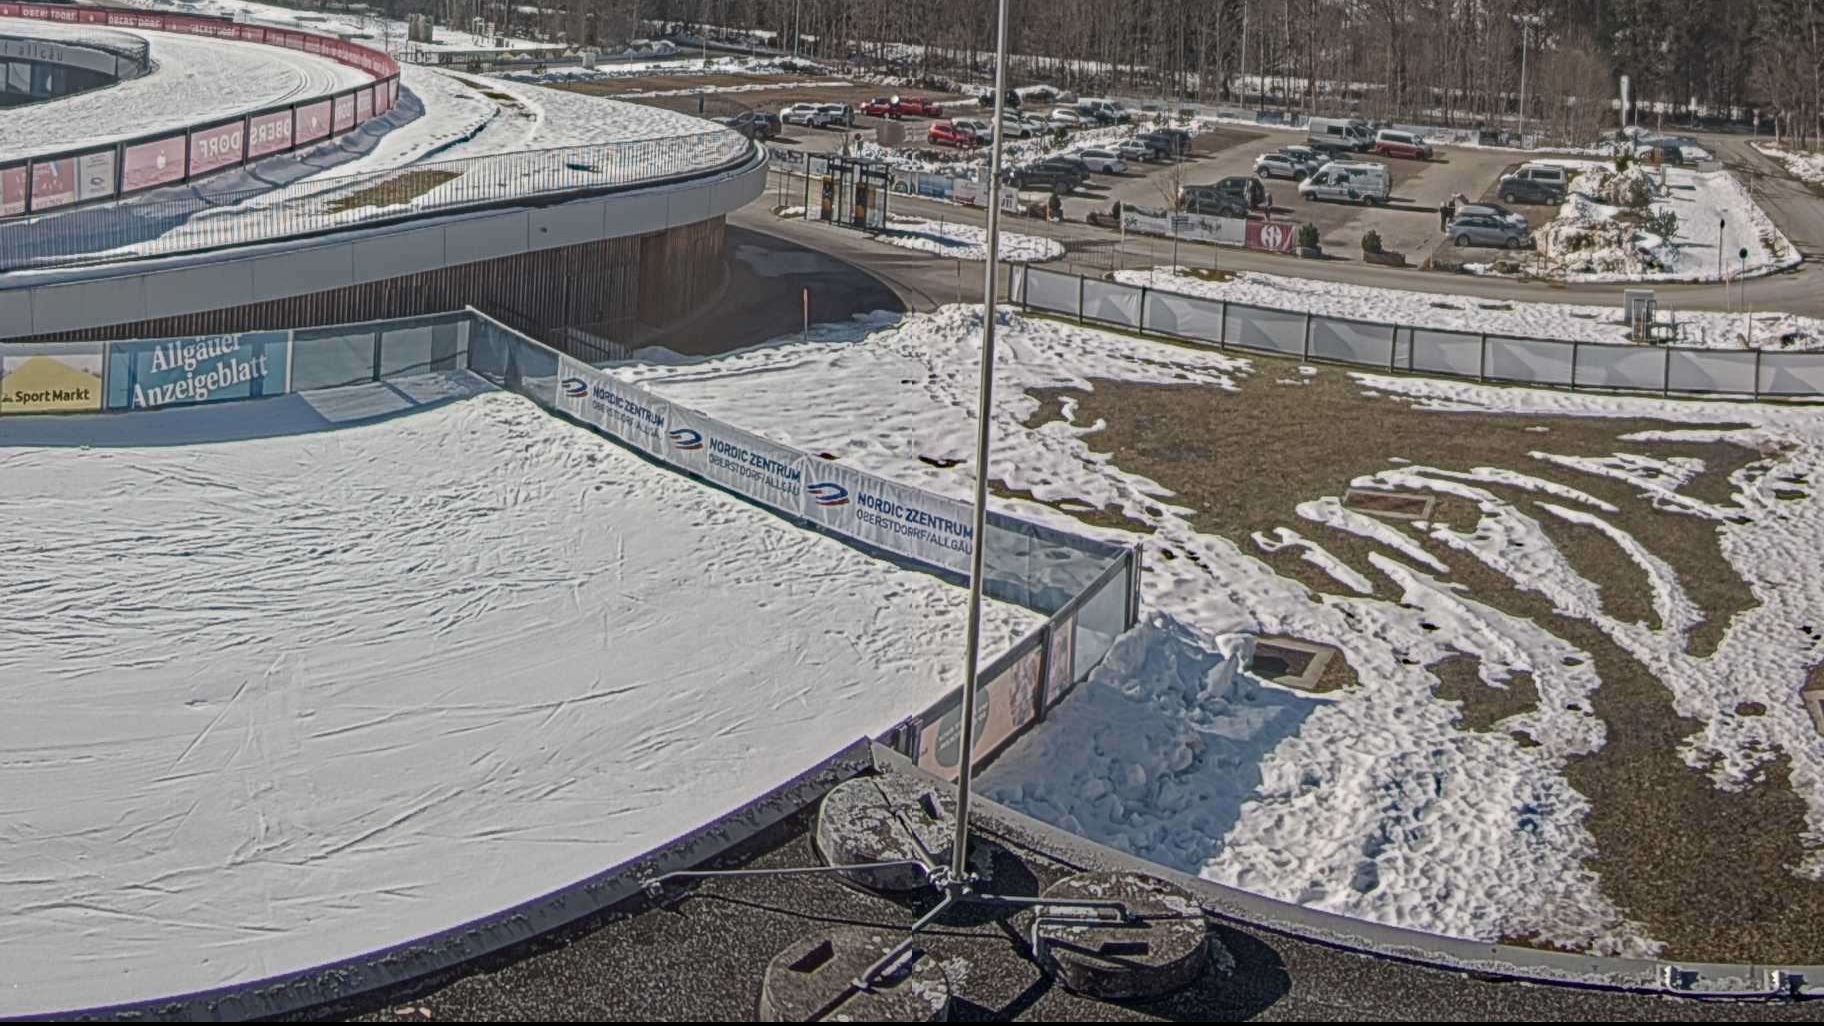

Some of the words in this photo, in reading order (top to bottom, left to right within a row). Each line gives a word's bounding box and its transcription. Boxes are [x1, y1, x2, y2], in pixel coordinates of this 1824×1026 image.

[150, 332, 243, 374] Allgäuer
[15, 390, 50, 405] Sport
[52, 387, 90, 402] Markt
[131, 353, 269, 409] Anzeigeblatt
[592, 385, 624, 410] NORDIC
[624, 399, 665, 428] ZENTRUM
[708, 437, 749, 463] NORDIC
[750, 452, 801, 483] ZENTRUM
[857, 491, 904, 519] NORDIC
